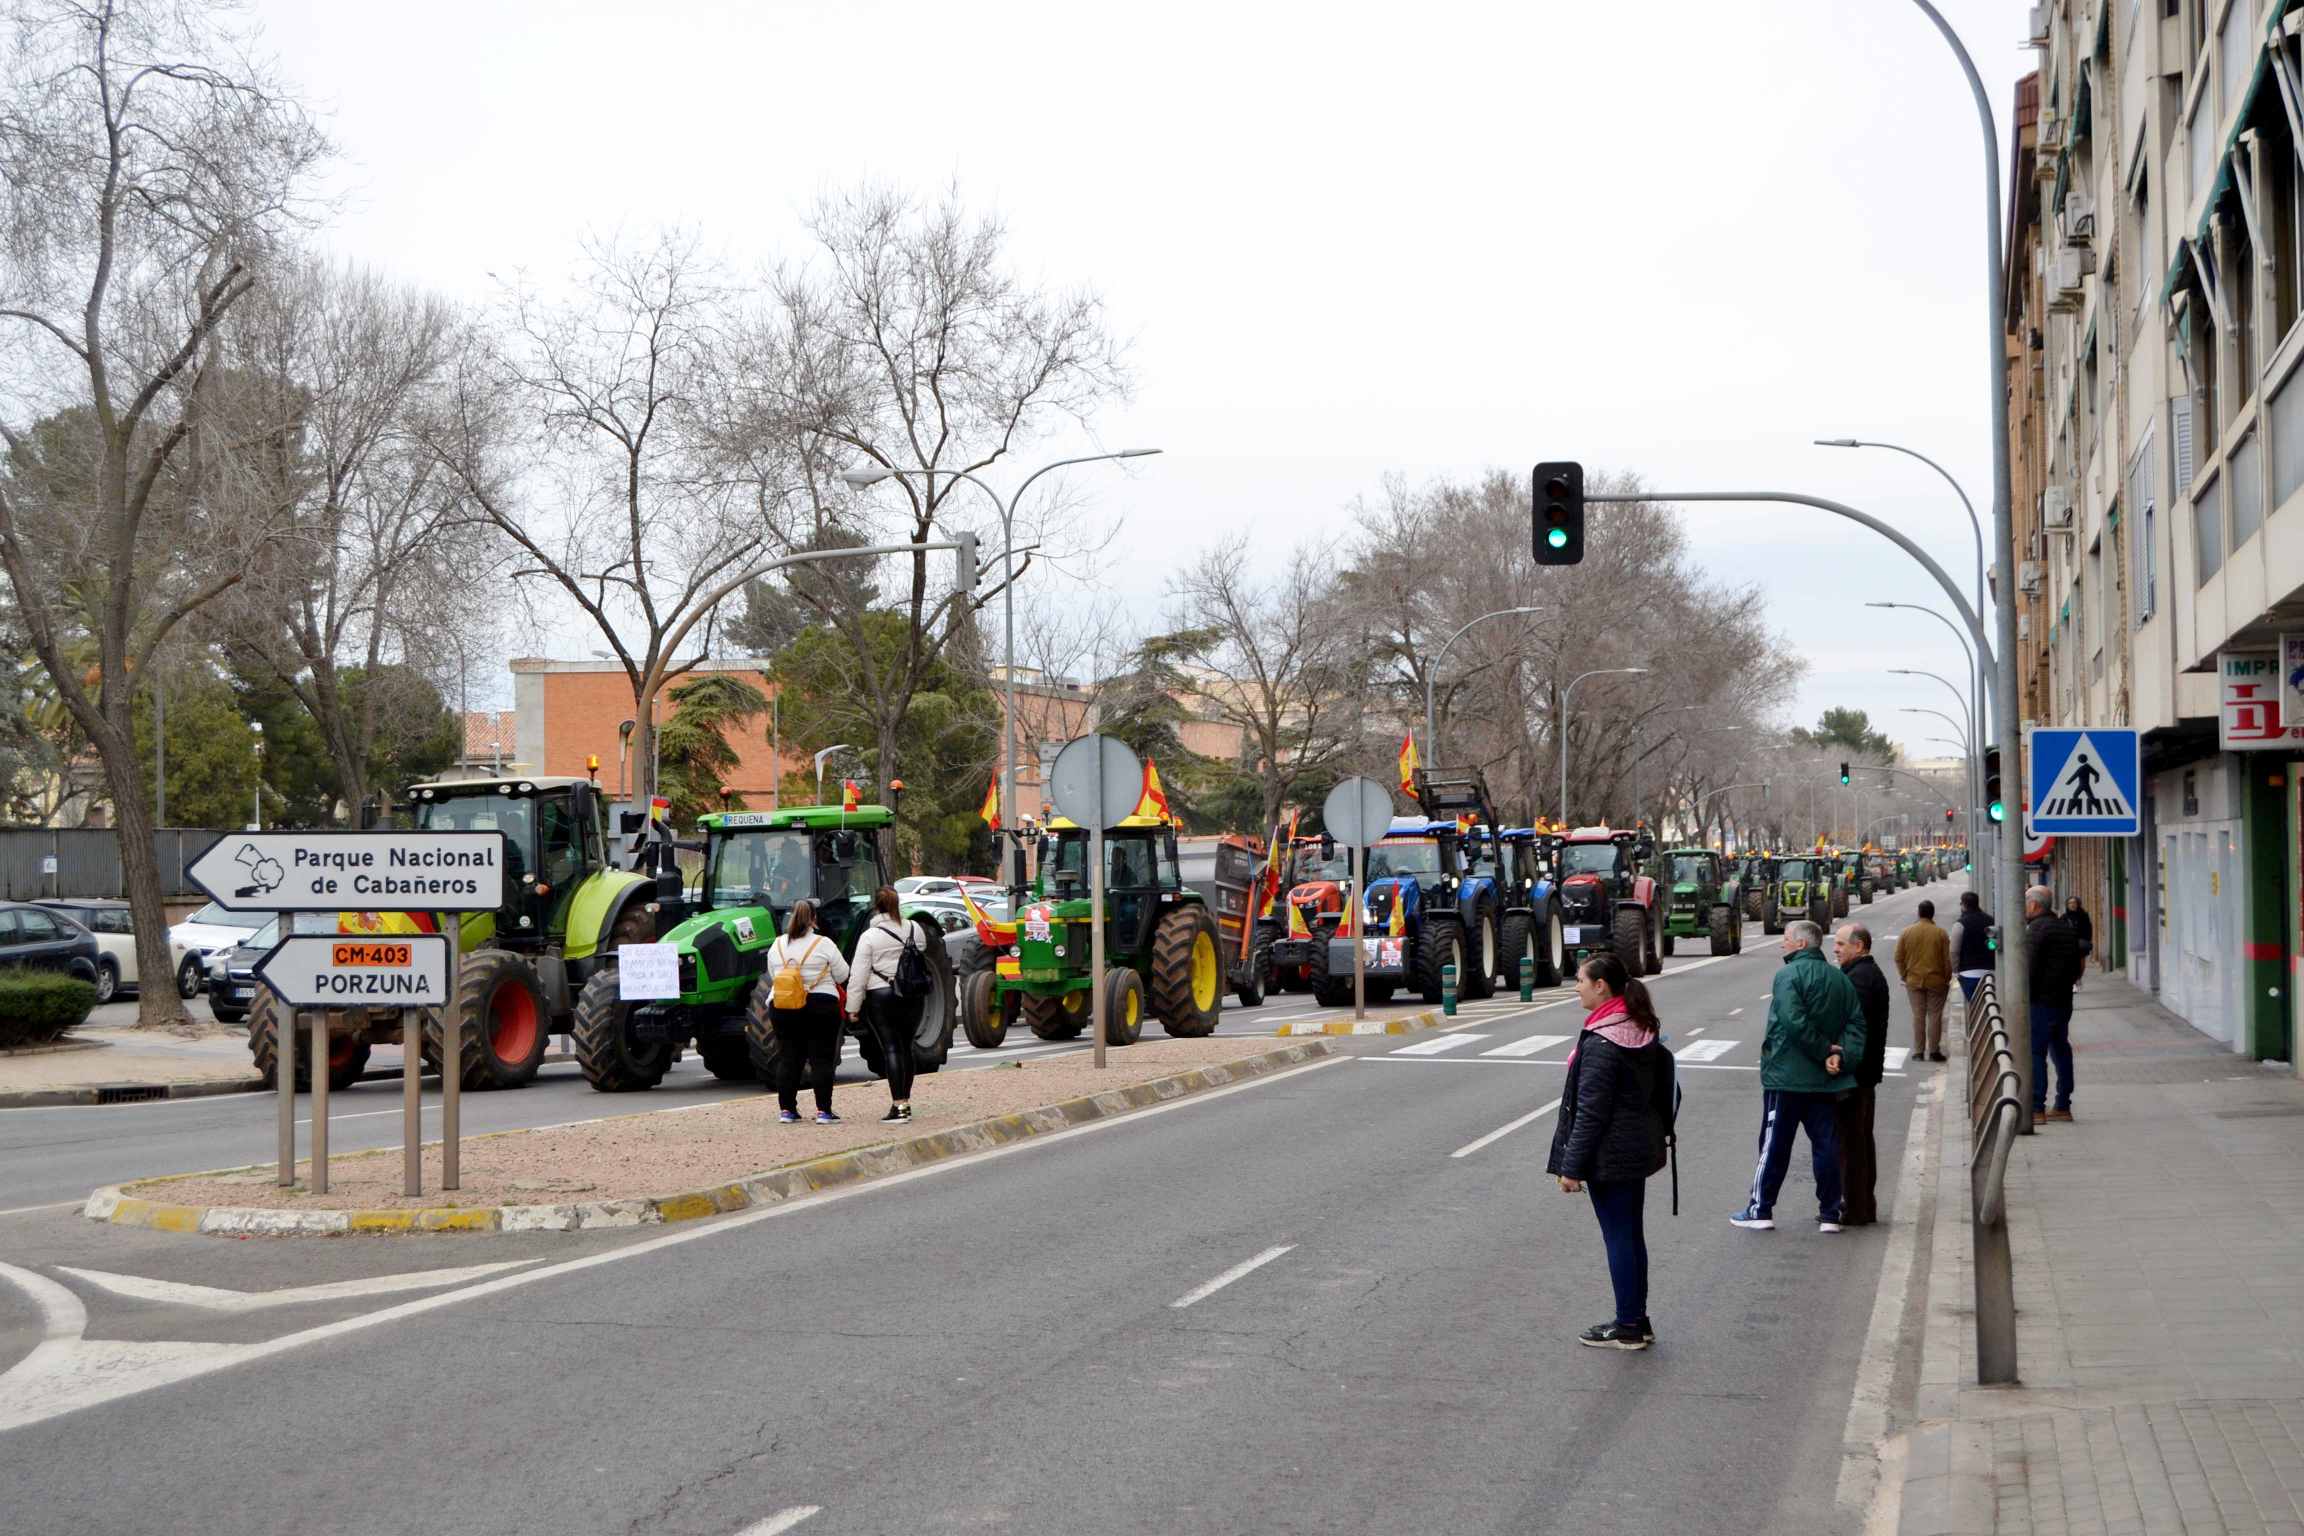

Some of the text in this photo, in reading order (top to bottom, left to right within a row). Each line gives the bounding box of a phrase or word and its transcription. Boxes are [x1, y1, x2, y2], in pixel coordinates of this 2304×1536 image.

[728, 815, 765, 826] REQUENA
[294, 847, 495, 872] Parque Nacional
[310, 874, 478, 895] de Cabañeros
[335, 946, 409, 964] CM-403
[315, 974, 430, 994] PORZUNA
